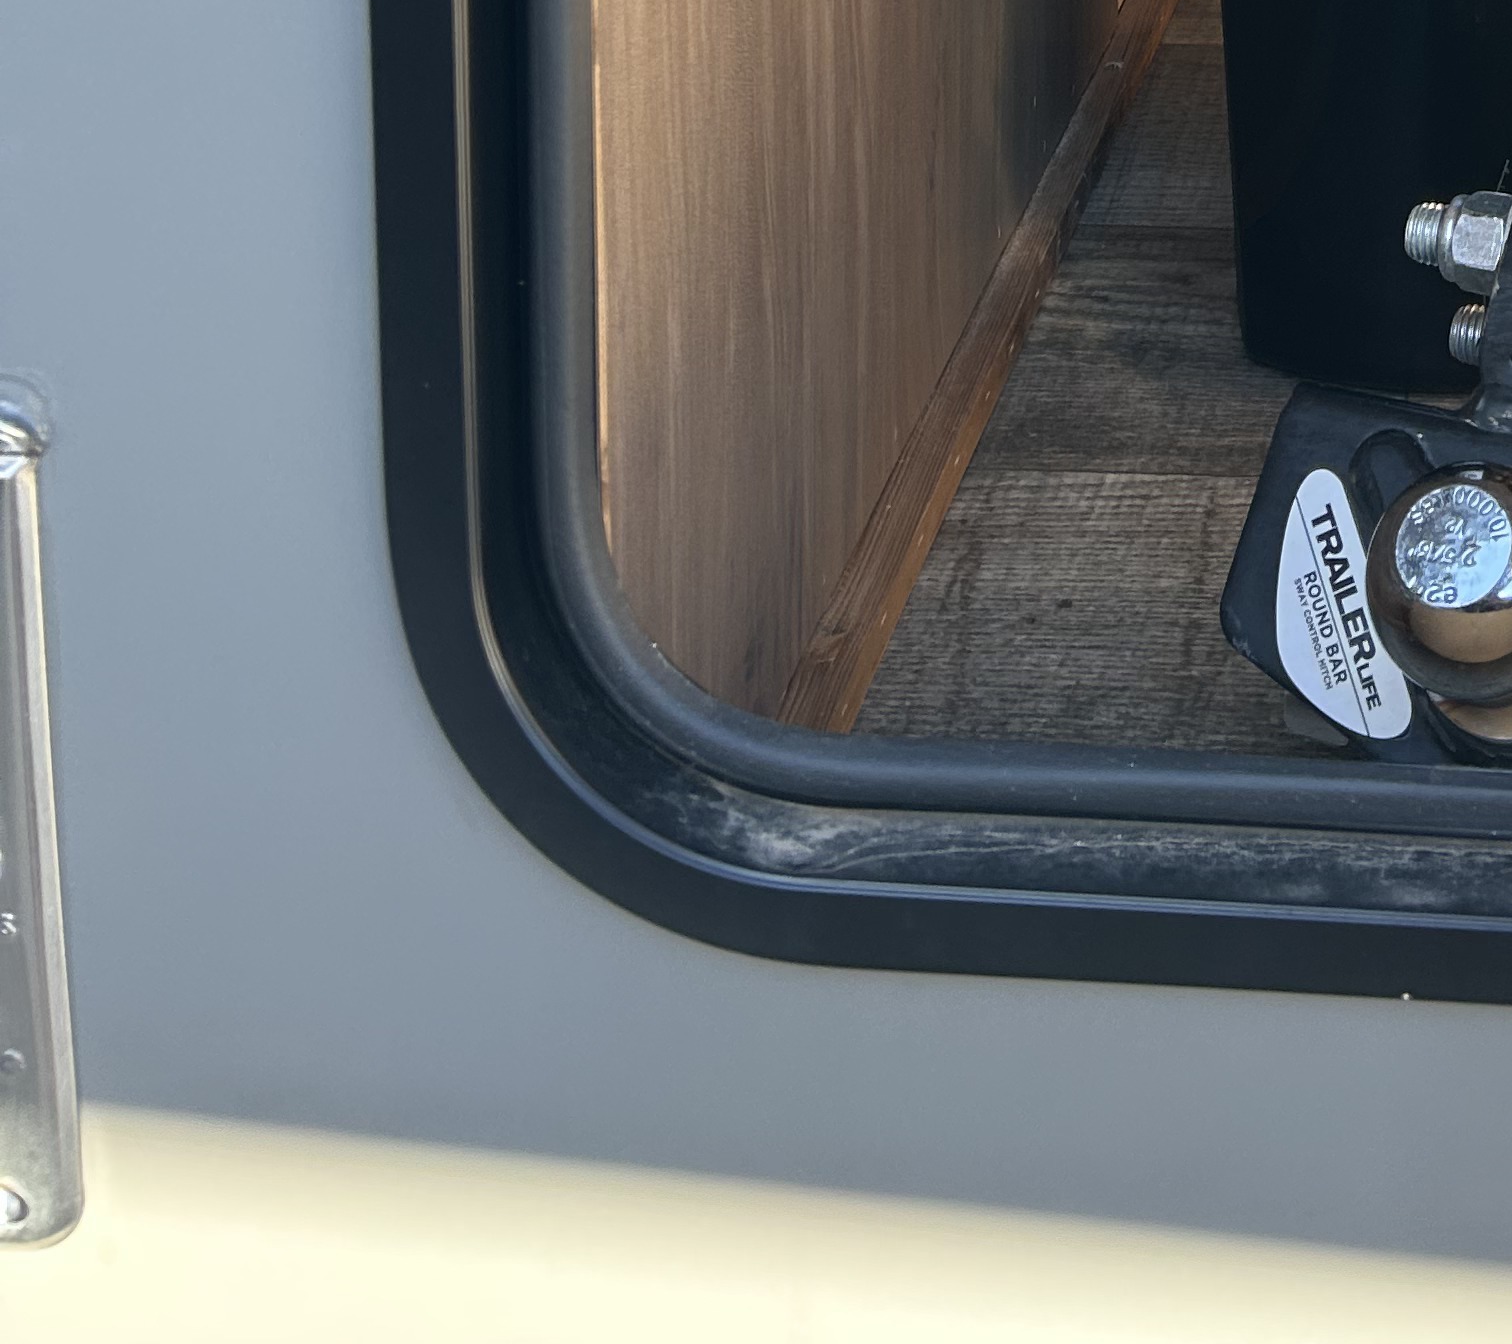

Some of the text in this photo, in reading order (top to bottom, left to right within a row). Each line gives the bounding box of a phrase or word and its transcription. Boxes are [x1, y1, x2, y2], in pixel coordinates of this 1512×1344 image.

[1293, 577, 1334, 690] SWAY CONTROL HITCH
[1303, 570, 1348, 684] ROUND BAR
[1310, 502, 1382, 711] TRAILER LIFE
